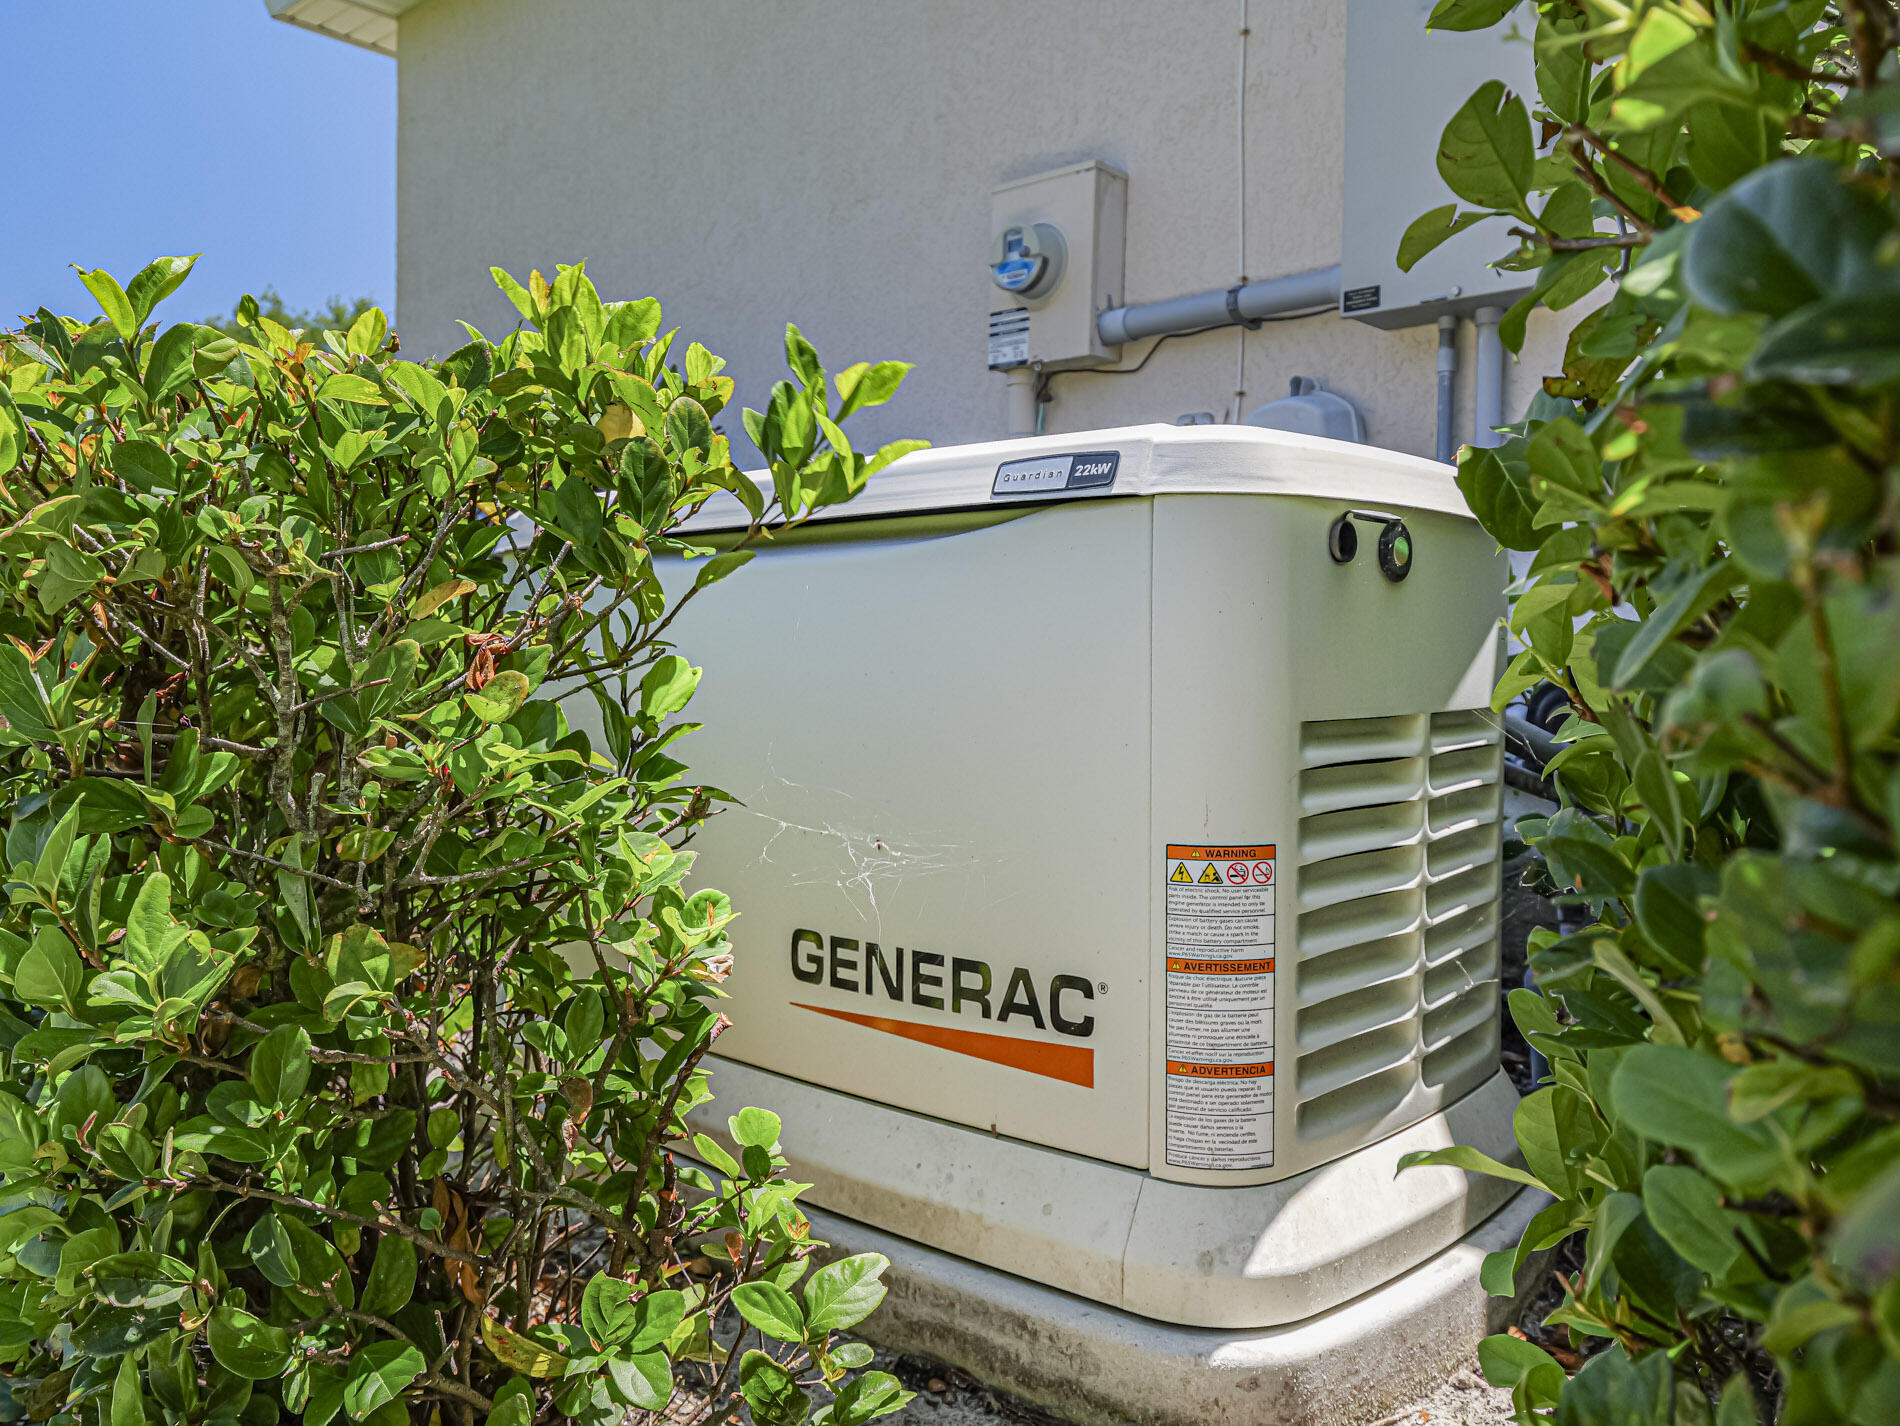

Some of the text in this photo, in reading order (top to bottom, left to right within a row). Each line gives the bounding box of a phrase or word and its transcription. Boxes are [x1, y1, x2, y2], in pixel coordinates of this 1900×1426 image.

[1003, 462, 1112, 482] Guardian 22kW
[1205, 849, 1256, 858] WARNING
[1184, 962, 1271, 972] AVERTISSEMENT
[1192, 1066, 1266, 1075] ADVERTENCIA
